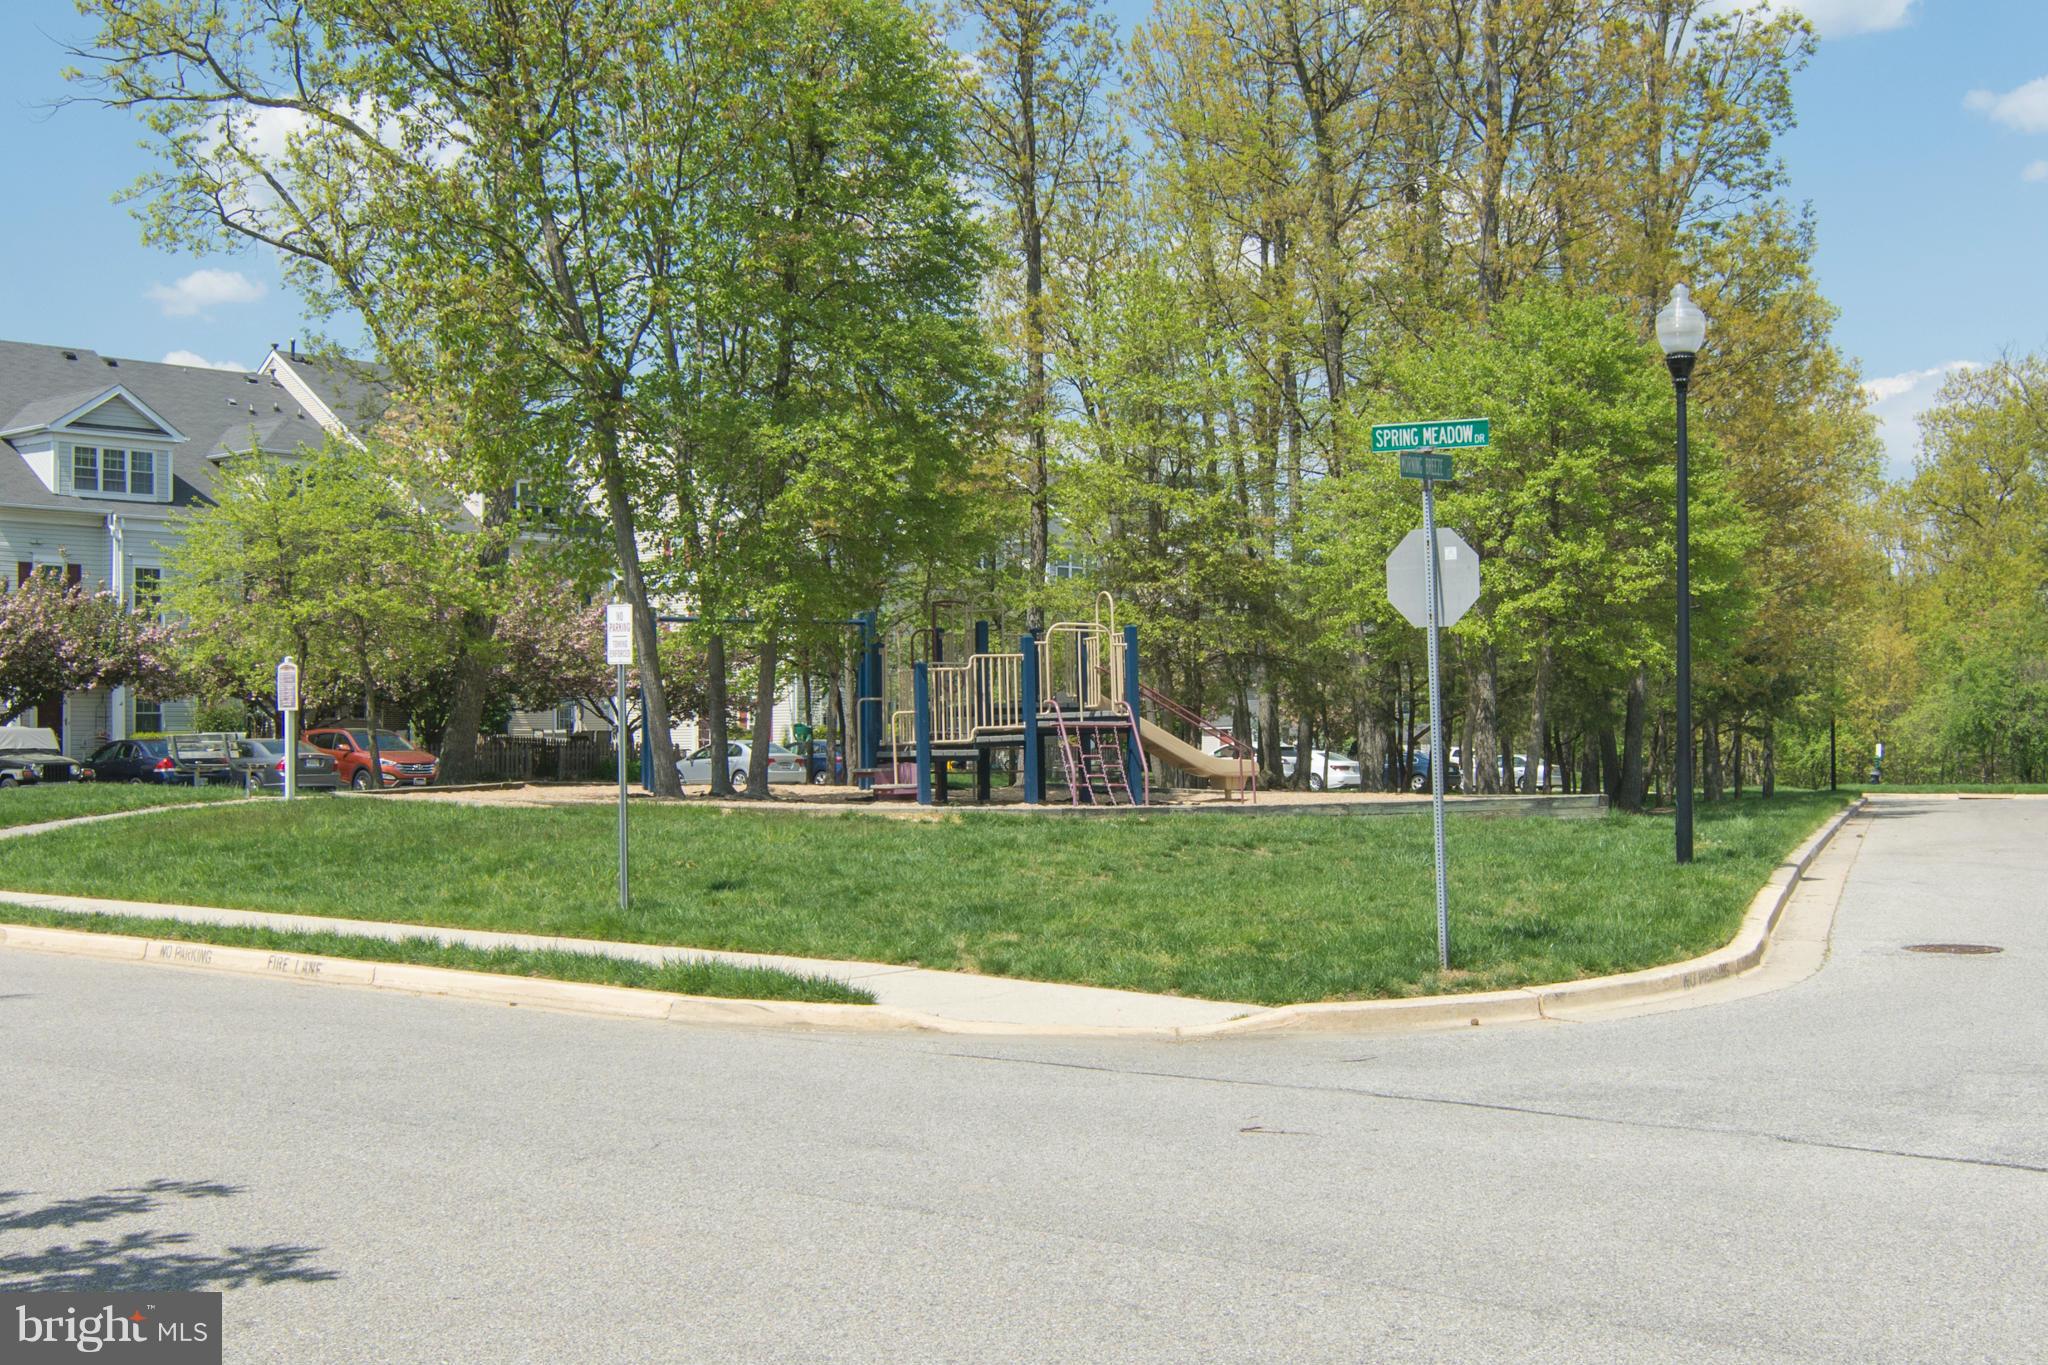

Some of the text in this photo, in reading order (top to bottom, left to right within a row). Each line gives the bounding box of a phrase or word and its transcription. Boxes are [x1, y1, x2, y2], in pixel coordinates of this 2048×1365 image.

[1375, 425, 1485, 447] SPRING MEADOW DR
[616, 611, 623, 621] NO
[609, 623, 630, 632] PARKING
[159, 944, 213, 964] NO PARKING
[267, 954, 323, 976] FIRE LANE
